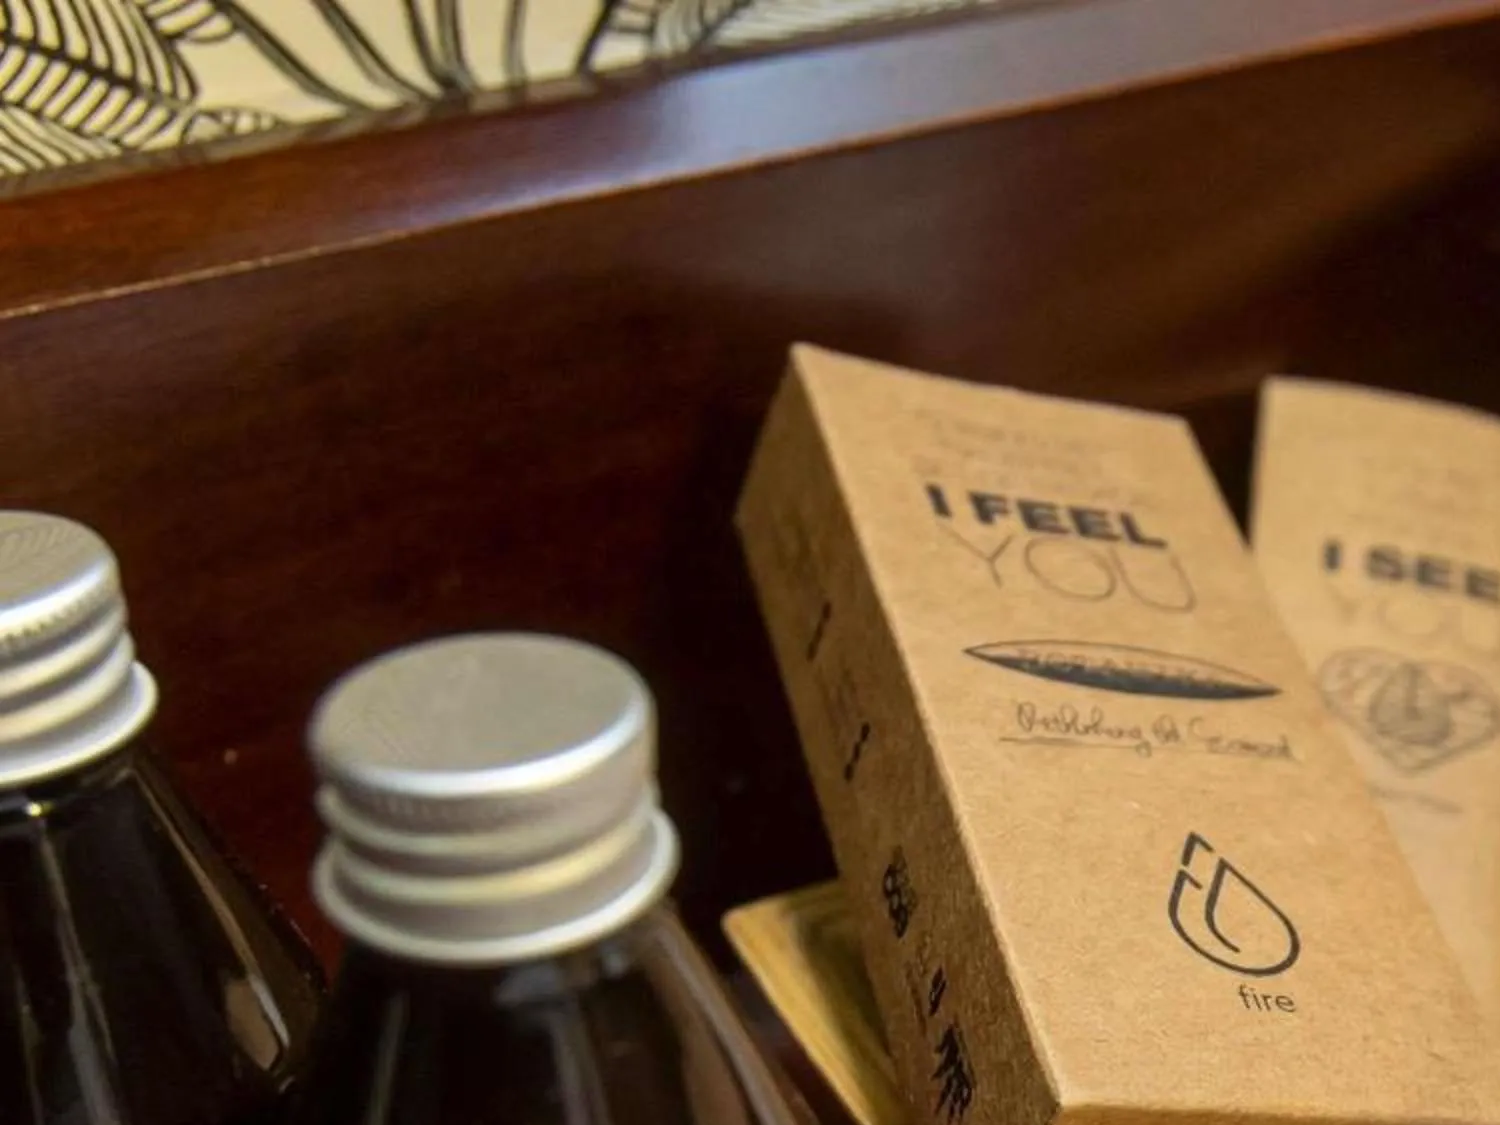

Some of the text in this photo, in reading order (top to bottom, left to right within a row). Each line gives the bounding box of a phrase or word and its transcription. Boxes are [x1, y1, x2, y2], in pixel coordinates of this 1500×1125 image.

[925, 483, 1168, 550] I FEEL
[938, 526, 1196, 613] YOU
[1323, 538, 1343, 576] I
[1238, 983, 1297, 1013] fire
